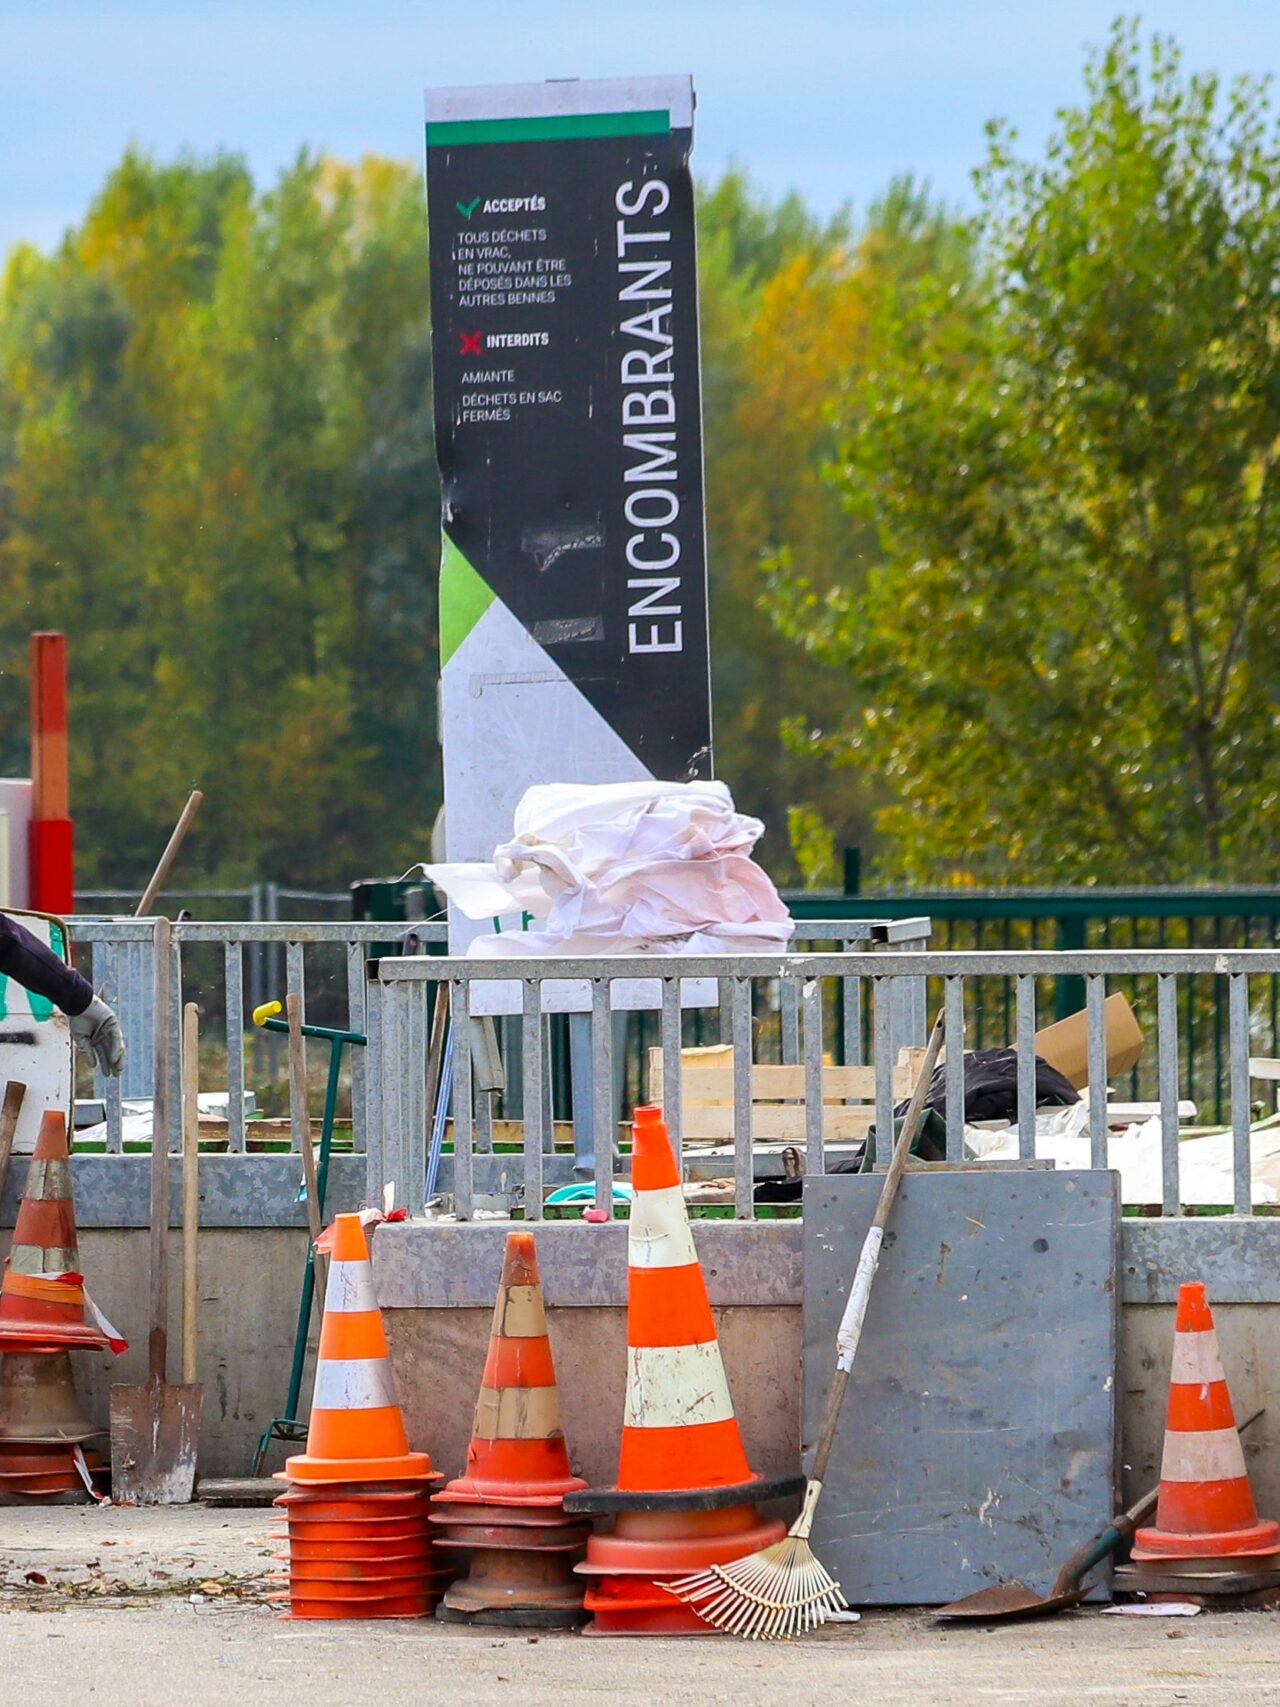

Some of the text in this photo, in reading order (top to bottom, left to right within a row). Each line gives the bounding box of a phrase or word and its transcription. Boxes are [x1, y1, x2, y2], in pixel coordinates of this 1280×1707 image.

[483, 194, 546, 213] ACCEPTÉS
[458, 228, 547, 244] TOUS DÉCHETS
[458, 246, 511, 260] EN VRAC,
[458, 257, 566, 276] NE POUVANT ÊTRE
[459, 274, 572, 292] DÉPOSÉS DANS LES
[459, 290, 556, 307] AUTRES BENNES
[486, 332, 549, 348] INTERDITS
[461, 370, 516, 384] AMIANTE
[462, 390, 562, 407] DÉCHETS EN SAC
[462, 407, 511, 422] FERMÉS
[615, 179, 683, 654] ENCOMBRANTS
